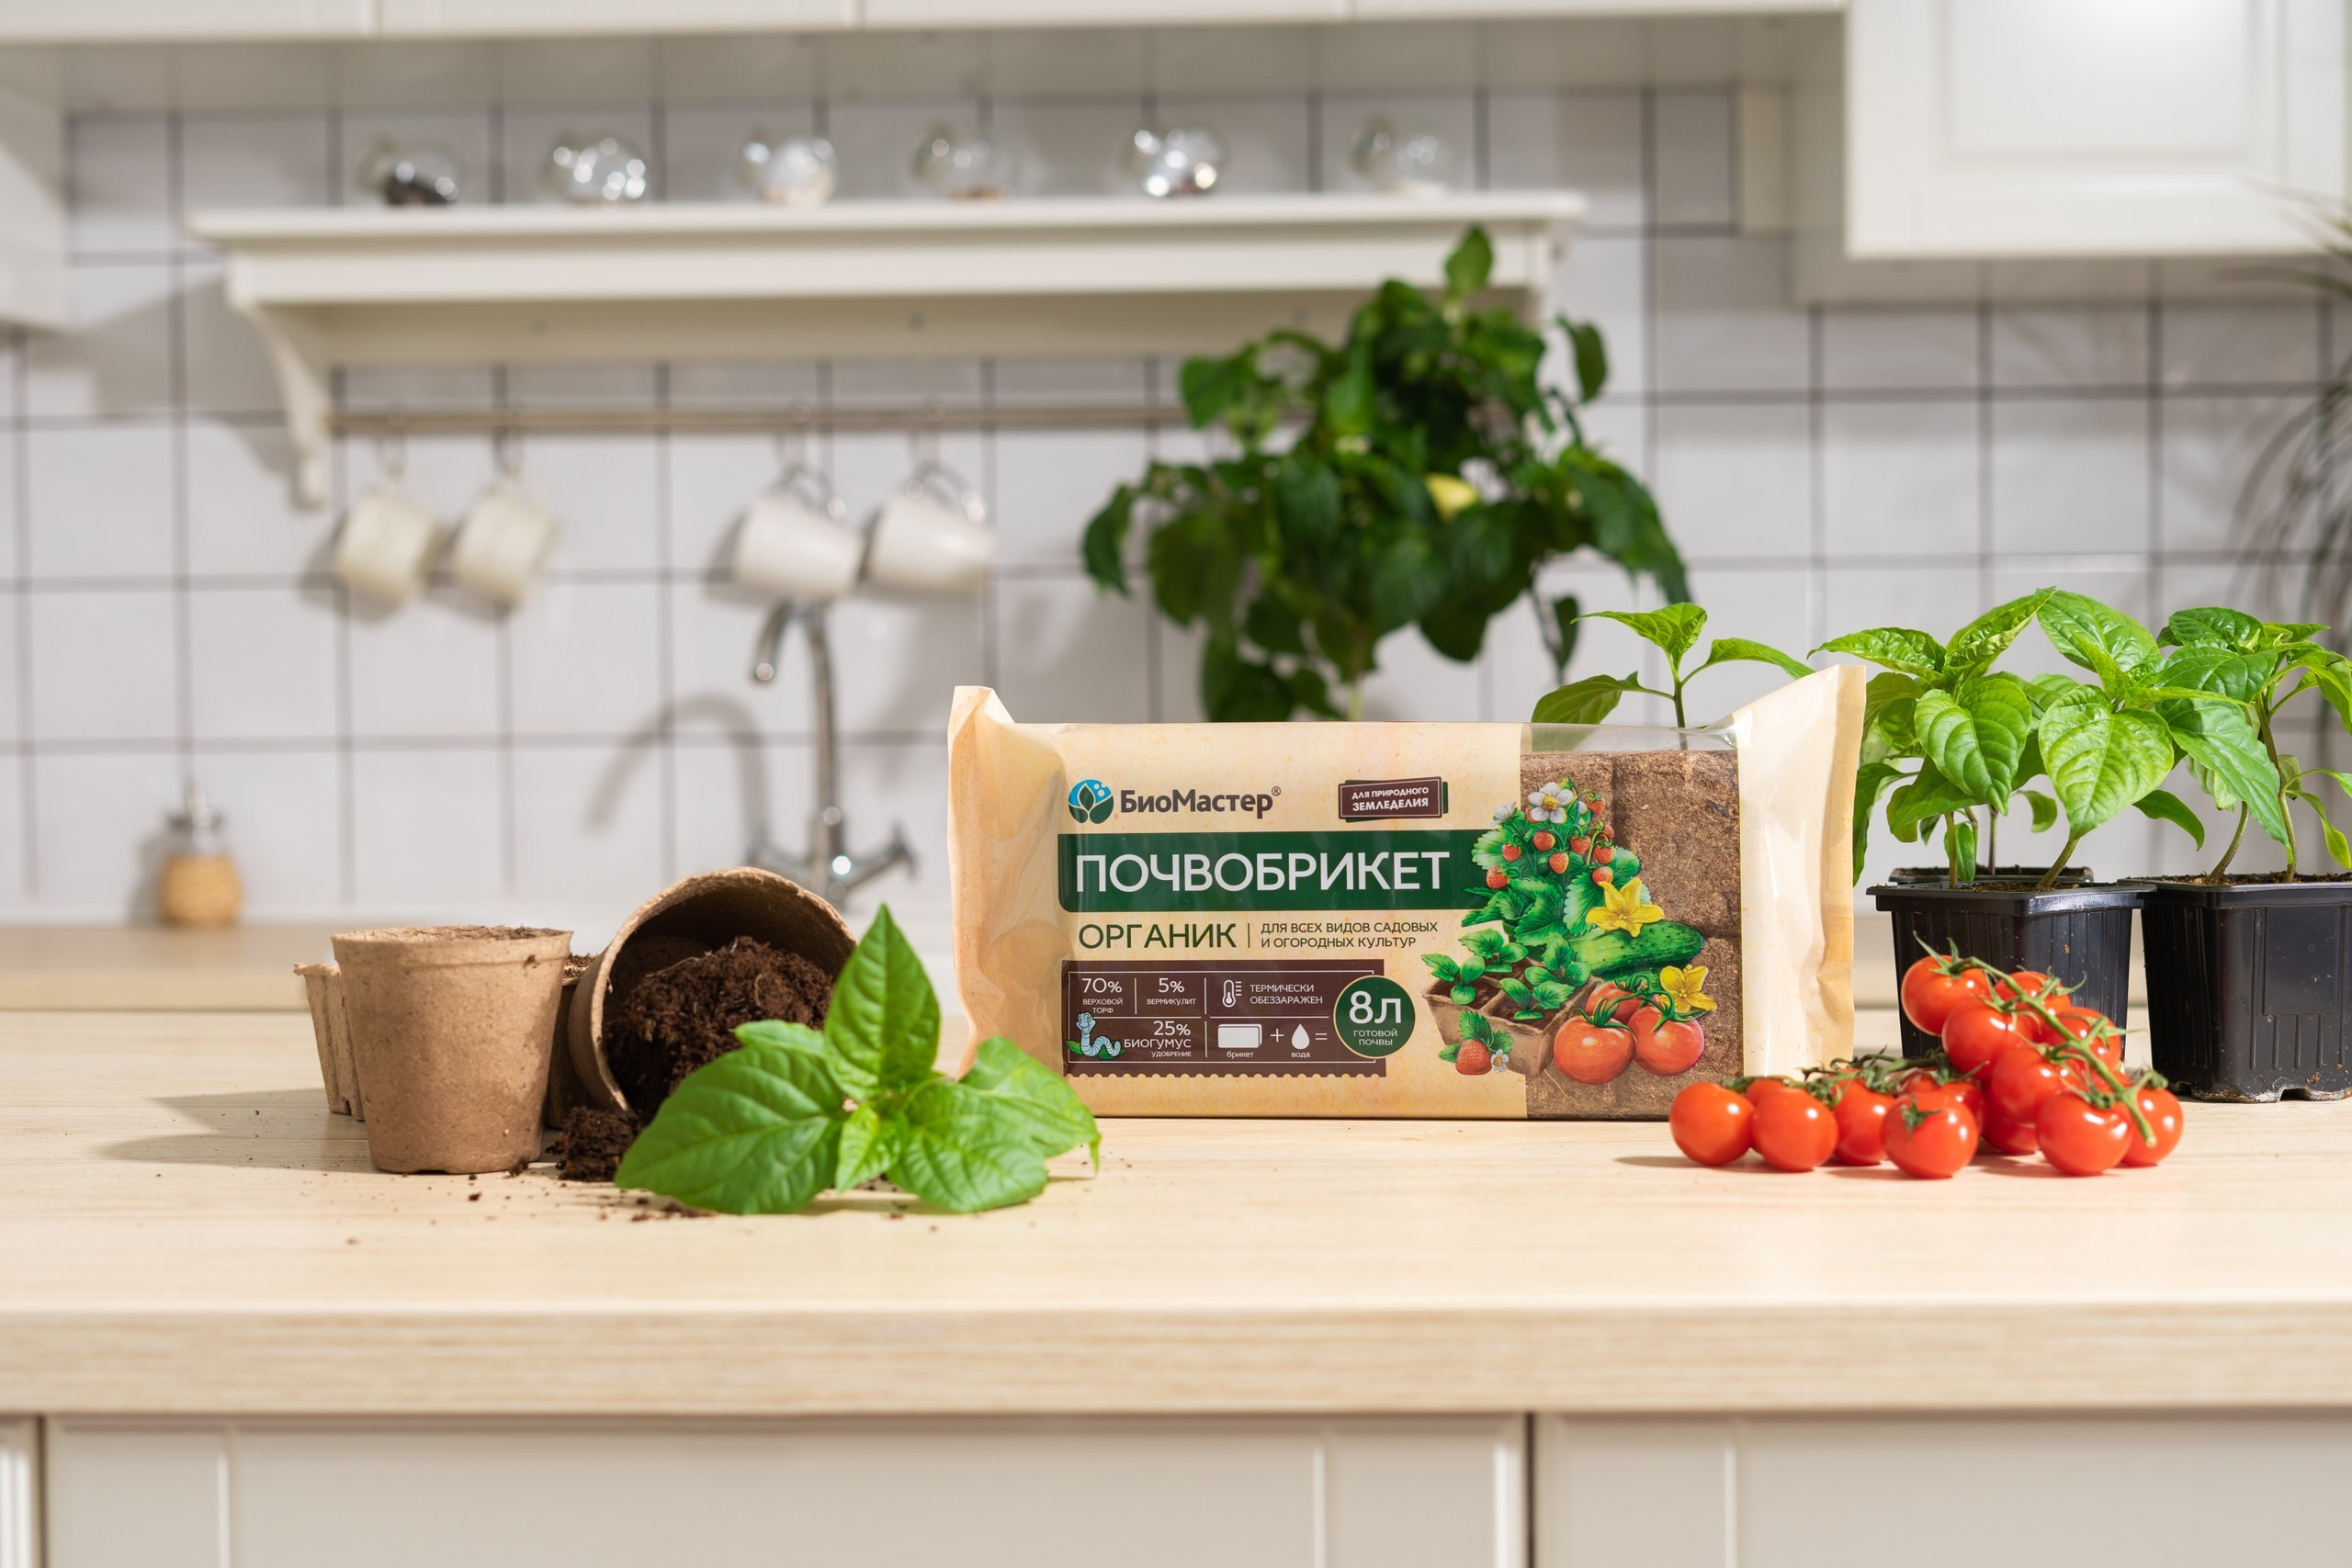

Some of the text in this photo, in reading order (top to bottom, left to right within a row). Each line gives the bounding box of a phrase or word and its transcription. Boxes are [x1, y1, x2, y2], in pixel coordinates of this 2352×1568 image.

[1351, 786, 1430, 800] ДЛЯ ПРИРОДНОГО
[1352, 797, 1429, 812] ЗЕМЛЕДЕЛИЯ
[1076, 852, 1450, 893] ПОЧВОБРИКЕТ
[1261, 921, 1439, 935] ДЛЯ ВСЕХ ВИДОВ САДОВЫХ
[1078, 922, 1238, 950] ОРГАНИК
[1261, 936, 1417, 950] И ОГОРОДНЫХ КУЛЬТУР
[1081, 977, 1123, 994] 70%
[1158, 977, 1185, 994] 5%
[1250, 984, 1315, 993] ТЕРМИЧЕСКИ
[1082, 998, 1124, 1006] ВЕРХОВОЙ
[1147, 998, 1197, 1006] ВЕРМИКУЛИТ
[1250, 996, 1323, 1005] ОБЕЗЗАРАЖЕН
[1153, 1021, 1192, 1036] 25%
[1353, 1028, 1398, 1037] ГОТОВОЙ
[1124, 1039, 1192, 1050] БИОГУМУС
[1358, 1038, 1393, 1046] ПОЧВЫ
[1227, 1050, 1254, 1059] брикет
